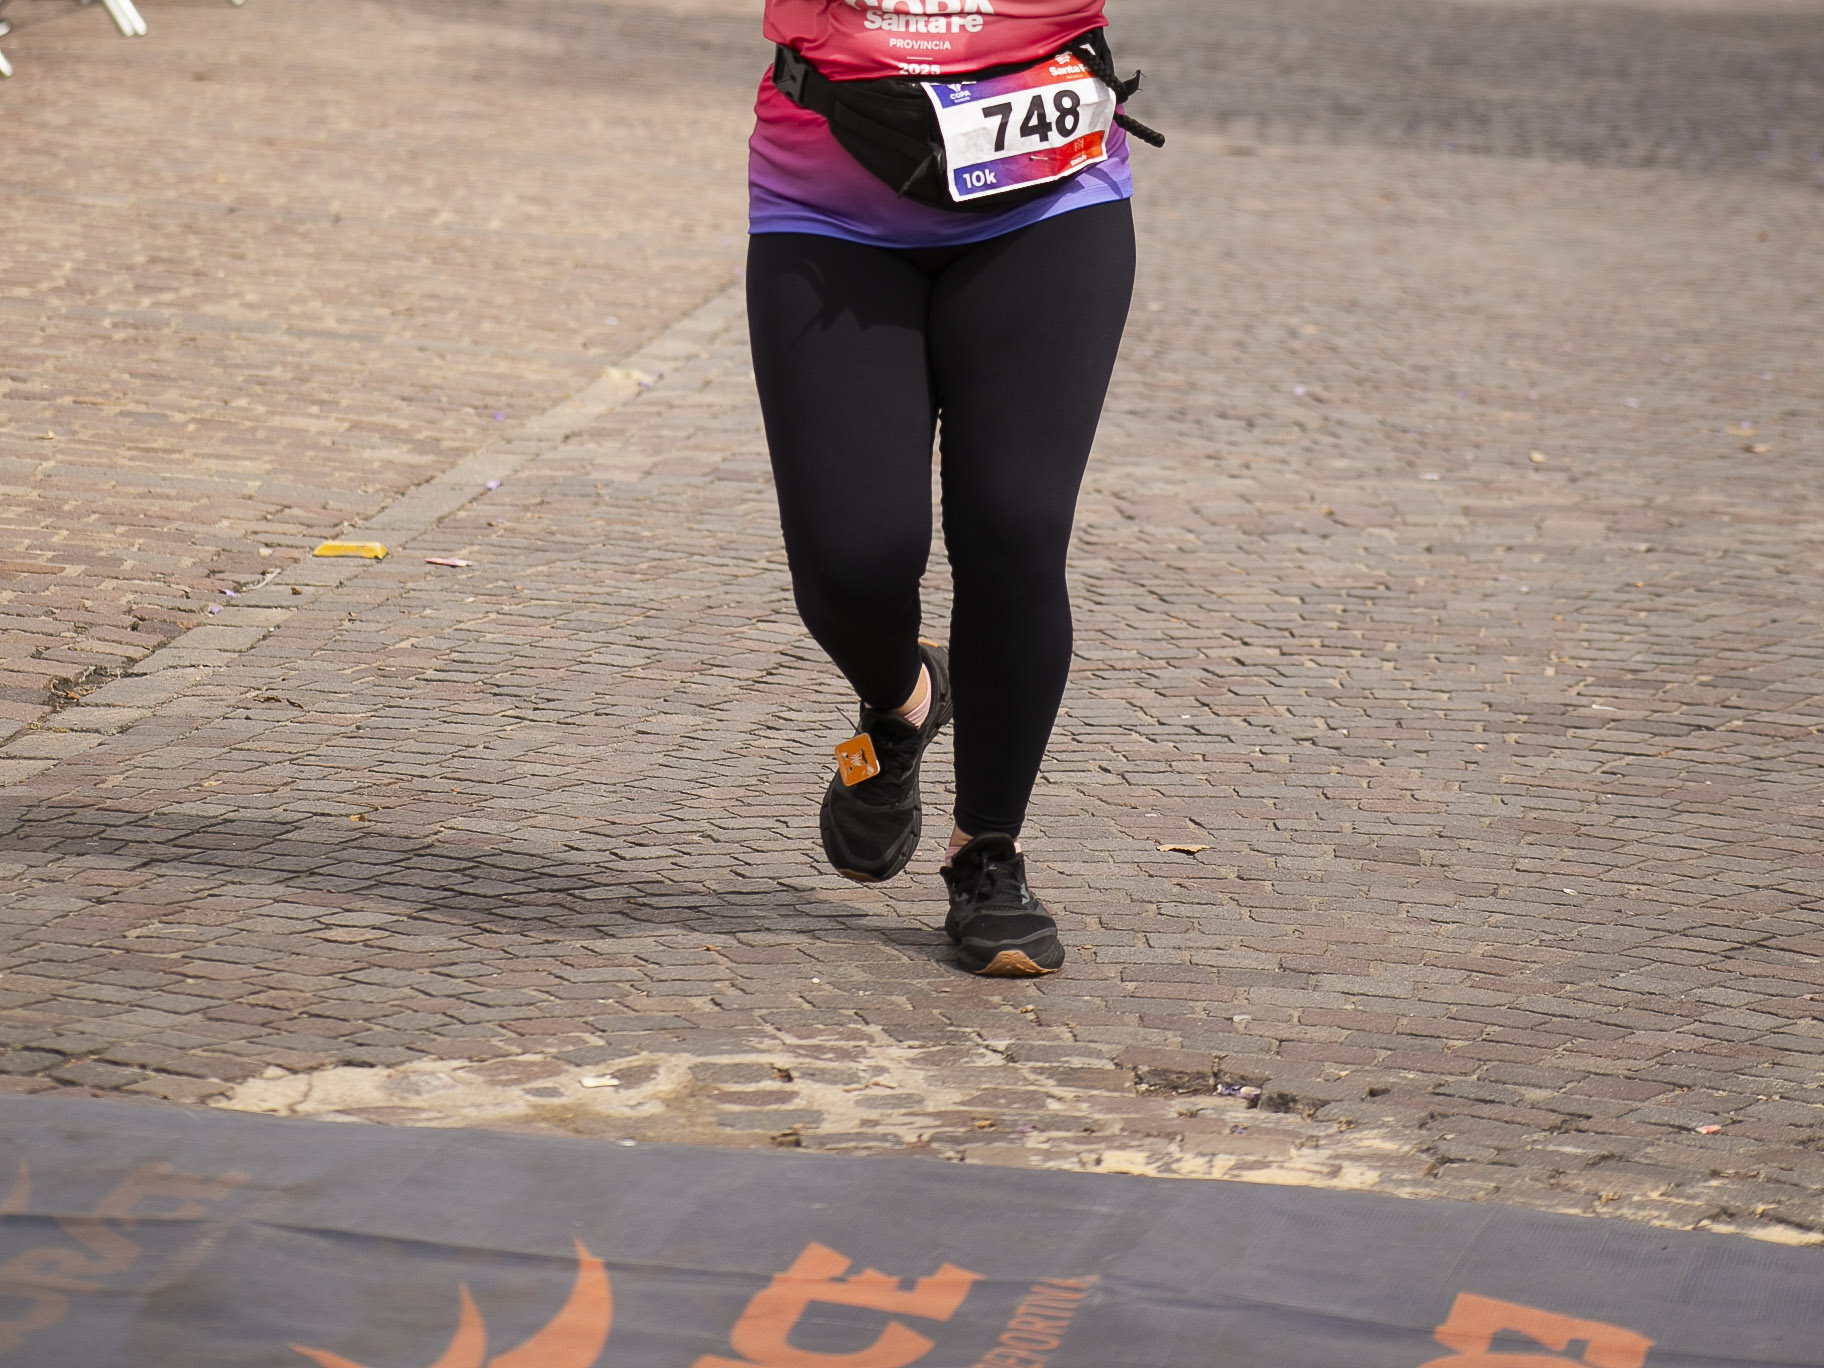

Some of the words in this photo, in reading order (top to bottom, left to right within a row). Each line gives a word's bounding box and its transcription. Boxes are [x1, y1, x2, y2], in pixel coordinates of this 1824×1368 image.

[864, 10, 947, 33] Santa
[889, 38, 952, 50] PROVINCIA
[898, 63, 941, 75] 2025
[949, 89, 972, 100] COPA
[981, 89, 1081, 153] 748
[962, 168, 997, 189] 10k
